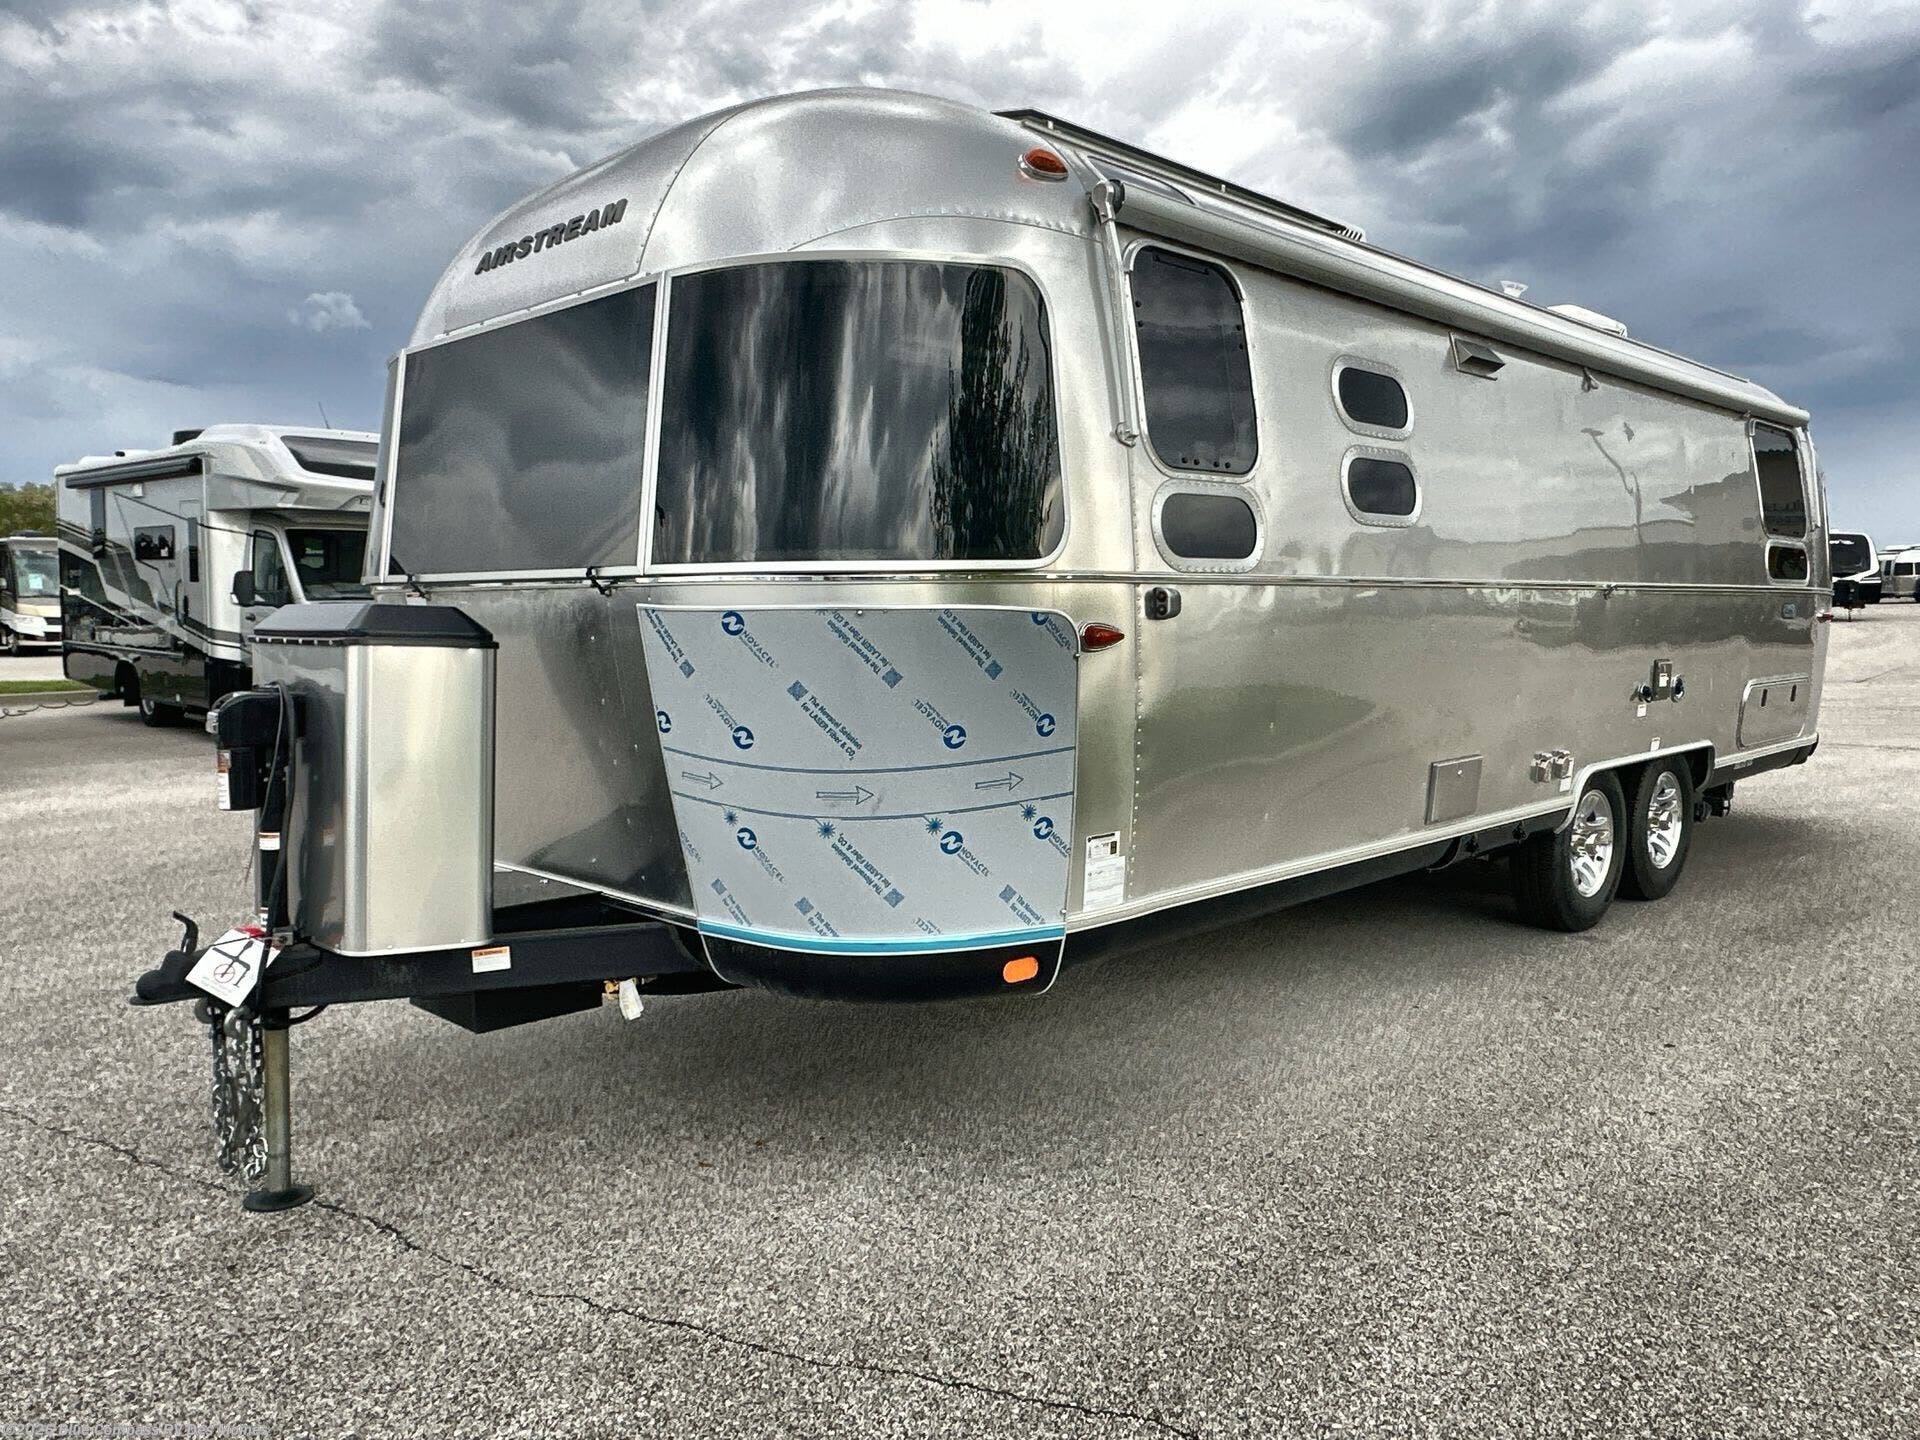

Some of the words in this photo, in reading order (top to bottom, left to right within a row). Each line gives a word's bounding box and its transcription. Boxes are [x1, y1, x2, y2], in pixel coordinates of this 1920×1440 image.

[474, 198, 628, 275] AIRSTREAM
[848, 626, 864, 641] Fiber
[967, 633, 985, 652] LASER
[742, 630, 776, 668] NOVACEL
[861, 640, 881, 659] LASER
[983, 649, 992, 660] for
[869, 662, 881, 675] The
[879, 656, 889, 667] for
[975, 654, 985, 668] The
[808, 695, 820, 708] The
[1012, 688, 1039, 721] NOVACEL
[705, 693, 735, 731] NOVACEL
[913, 698, 946, 732] NOVACEL
[800, 702, 810, 712] for
[808, 711, 828, 731] LASER
[826, 728, 842, 744] Fiber
[1050, 832, 1071, 855] NOVAC
[755, 846, 784, 882] NOVACEL
[851, 849, 866, 864] Fiber
[960, 847, 990, 877] NOVACEL
[863, 861, 883, 881] LASER
[872, 882, 883, 895] The
[881, 878, 891, 888] for
[815, 912, 825, 924] The
